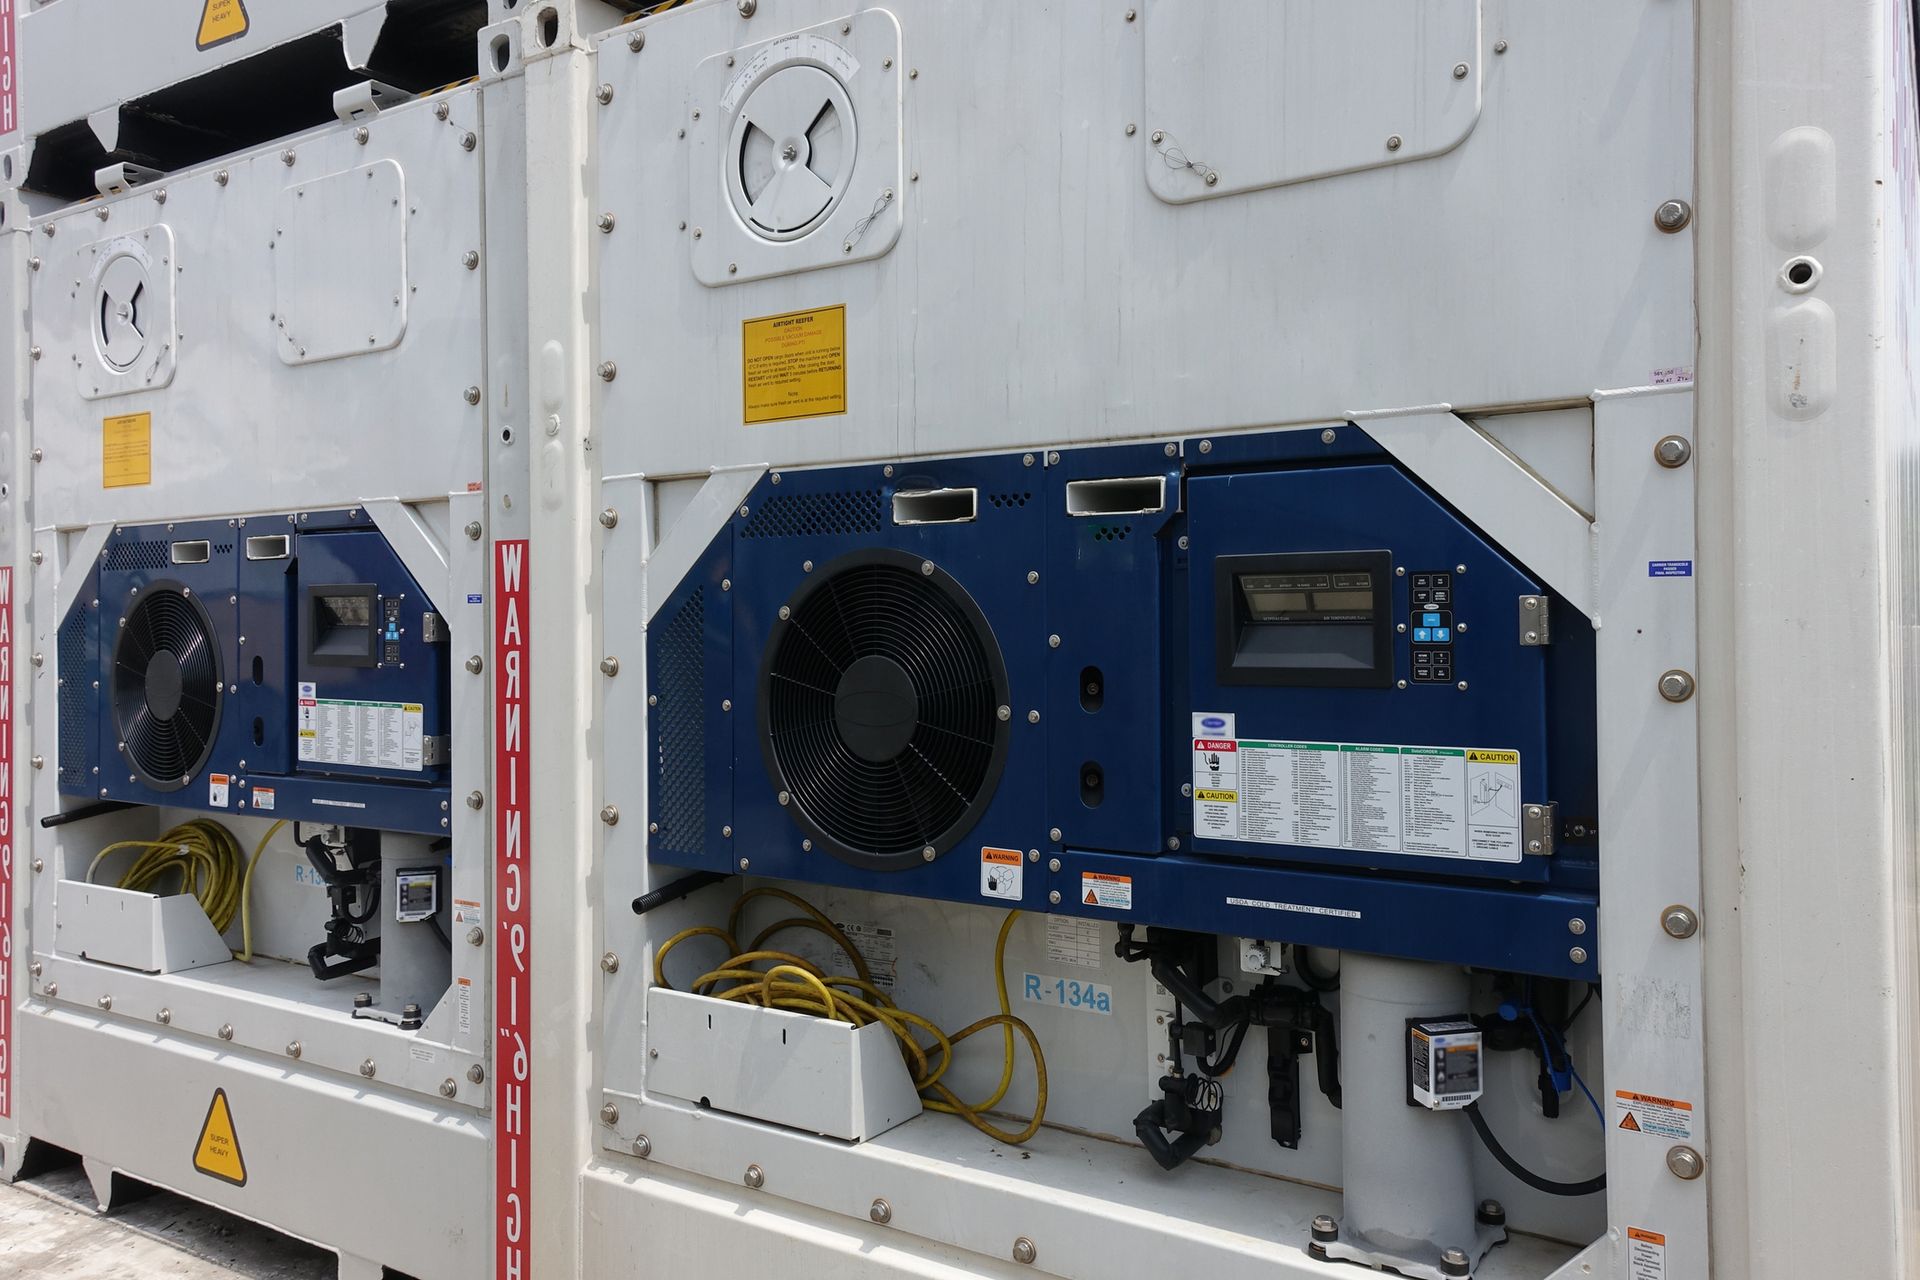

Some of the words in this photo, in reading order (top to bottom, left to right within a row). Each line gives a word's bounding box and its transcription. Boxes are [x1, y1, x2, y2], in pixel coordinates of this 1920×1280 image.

[773, 319, 794, 328] AIRTIGHT
[1208, 742, 1231, 750] DANGER
[1480, 753, 1515, 762] CAUTION
[1206, 792, 1234, 800] CAUTION
[993, 854, 1019, 862] WARNING
[1098, 874, 1120, 882] WARNING
[1252, 900, 1270, 908] COLD
[1274, 903, 1315, 913] TREATMENT
[1319, 908, 1357, 918] CERTIFIED
[1025, 974, 1110, 1012] R-134a
[1641, 1095, 1675, 1107] WARNING
[210, 1134, 229, 1145] SUPER
[210, 1146, 229, 1158] HEAVY
